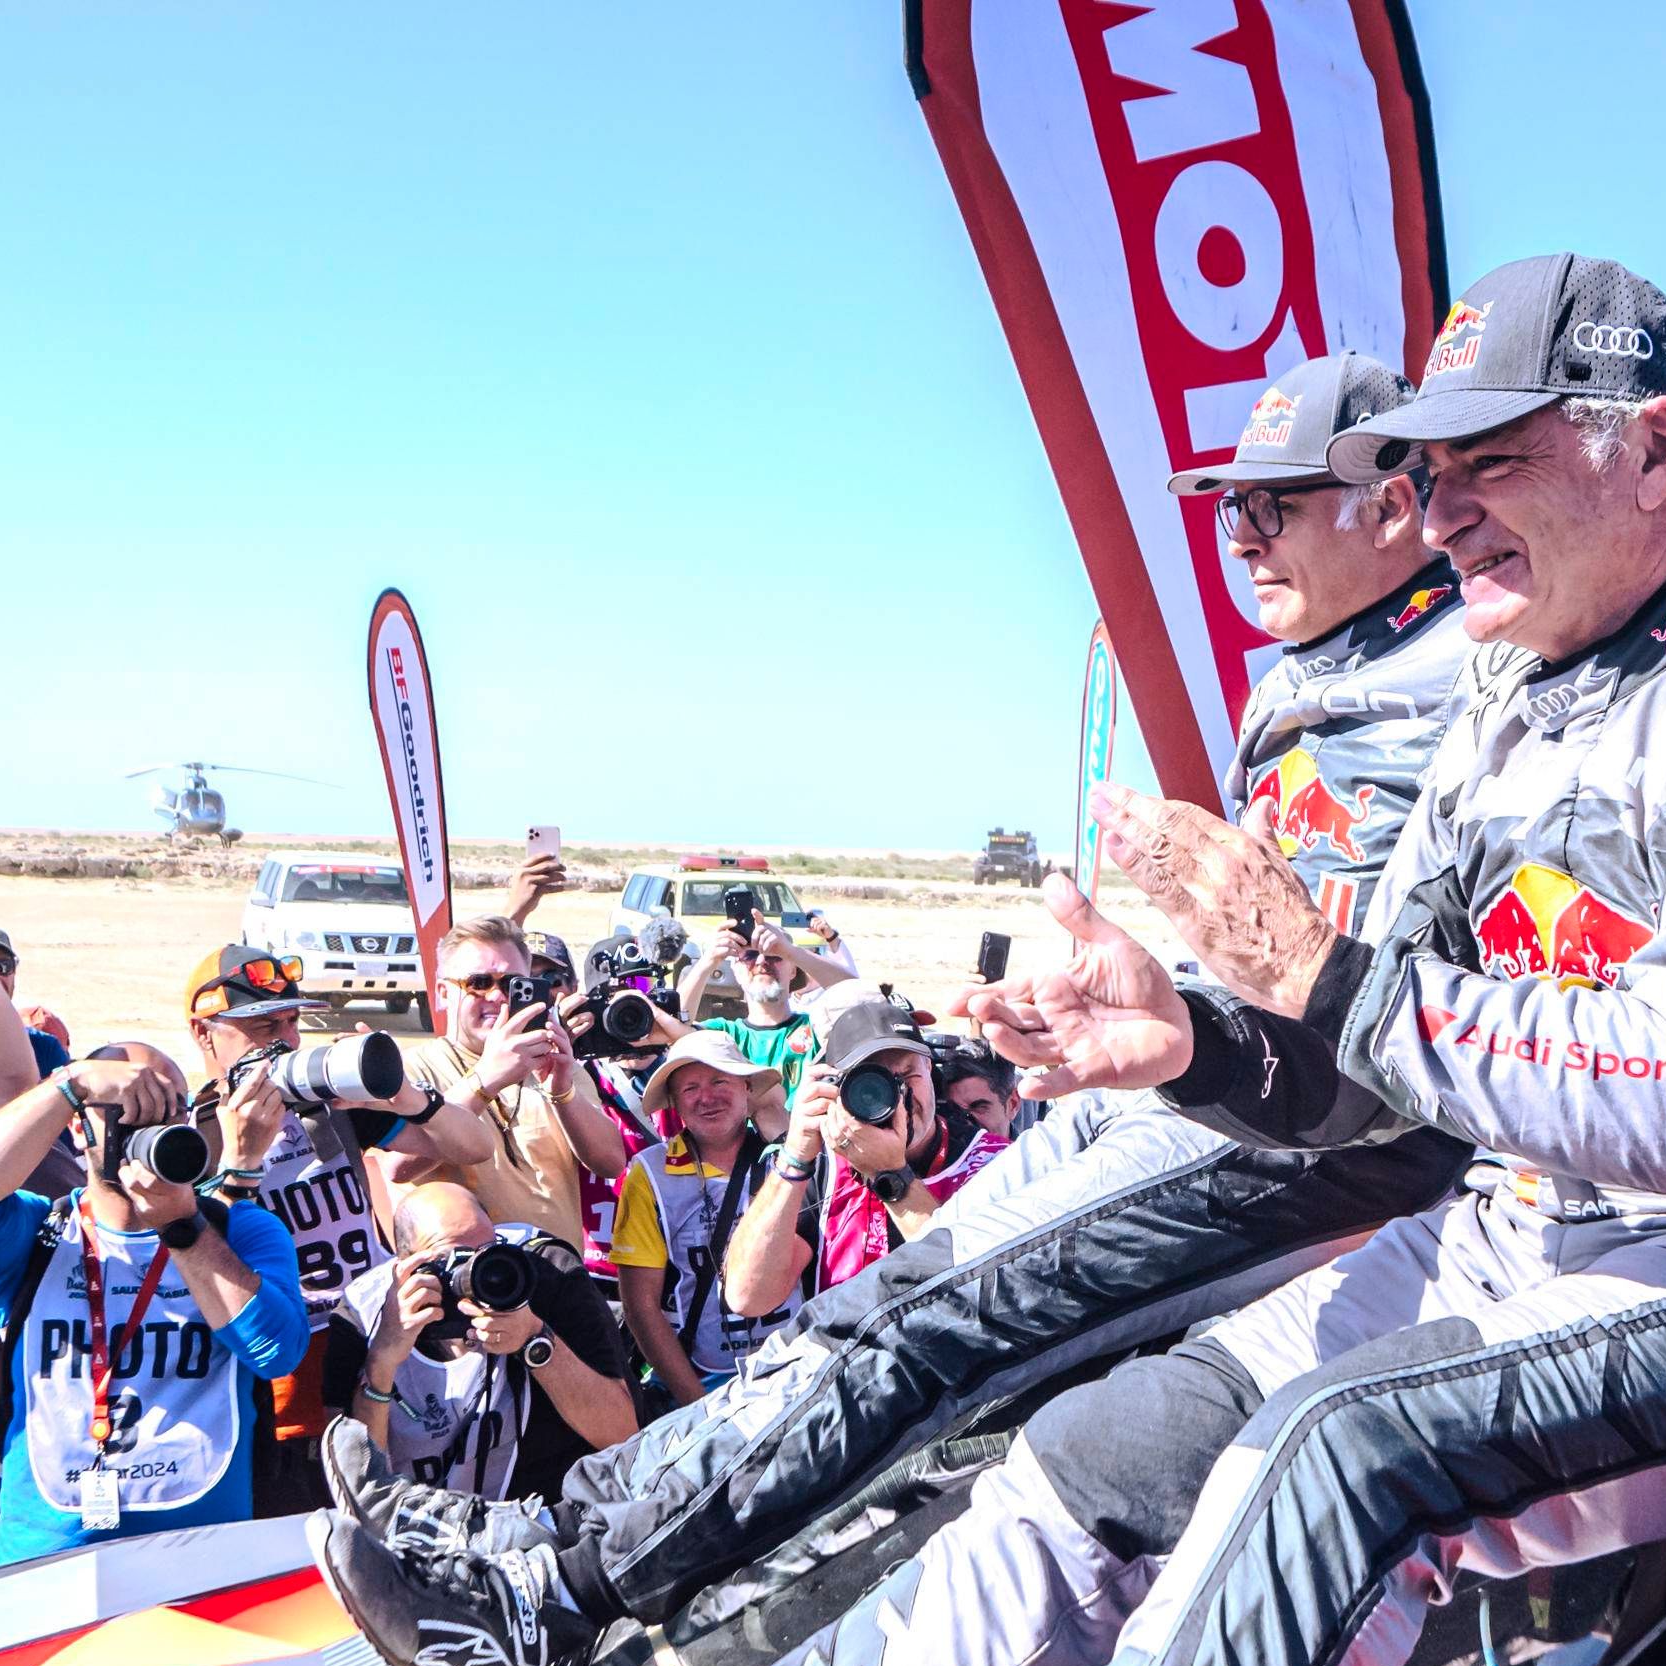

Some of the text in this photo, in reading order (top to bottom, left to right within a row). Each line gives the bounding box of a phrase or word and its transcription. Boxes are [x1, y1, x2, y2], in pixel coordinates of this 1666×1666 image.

[1437, 336, 1483, 368] Bull
[1256, 421, 1290, 443] Bull
[390, 648, 434, 883] BFGoodrich
[1455, 1024, 1552, 1066] Audi
[256, 1165, 365, 1236] HOTO
